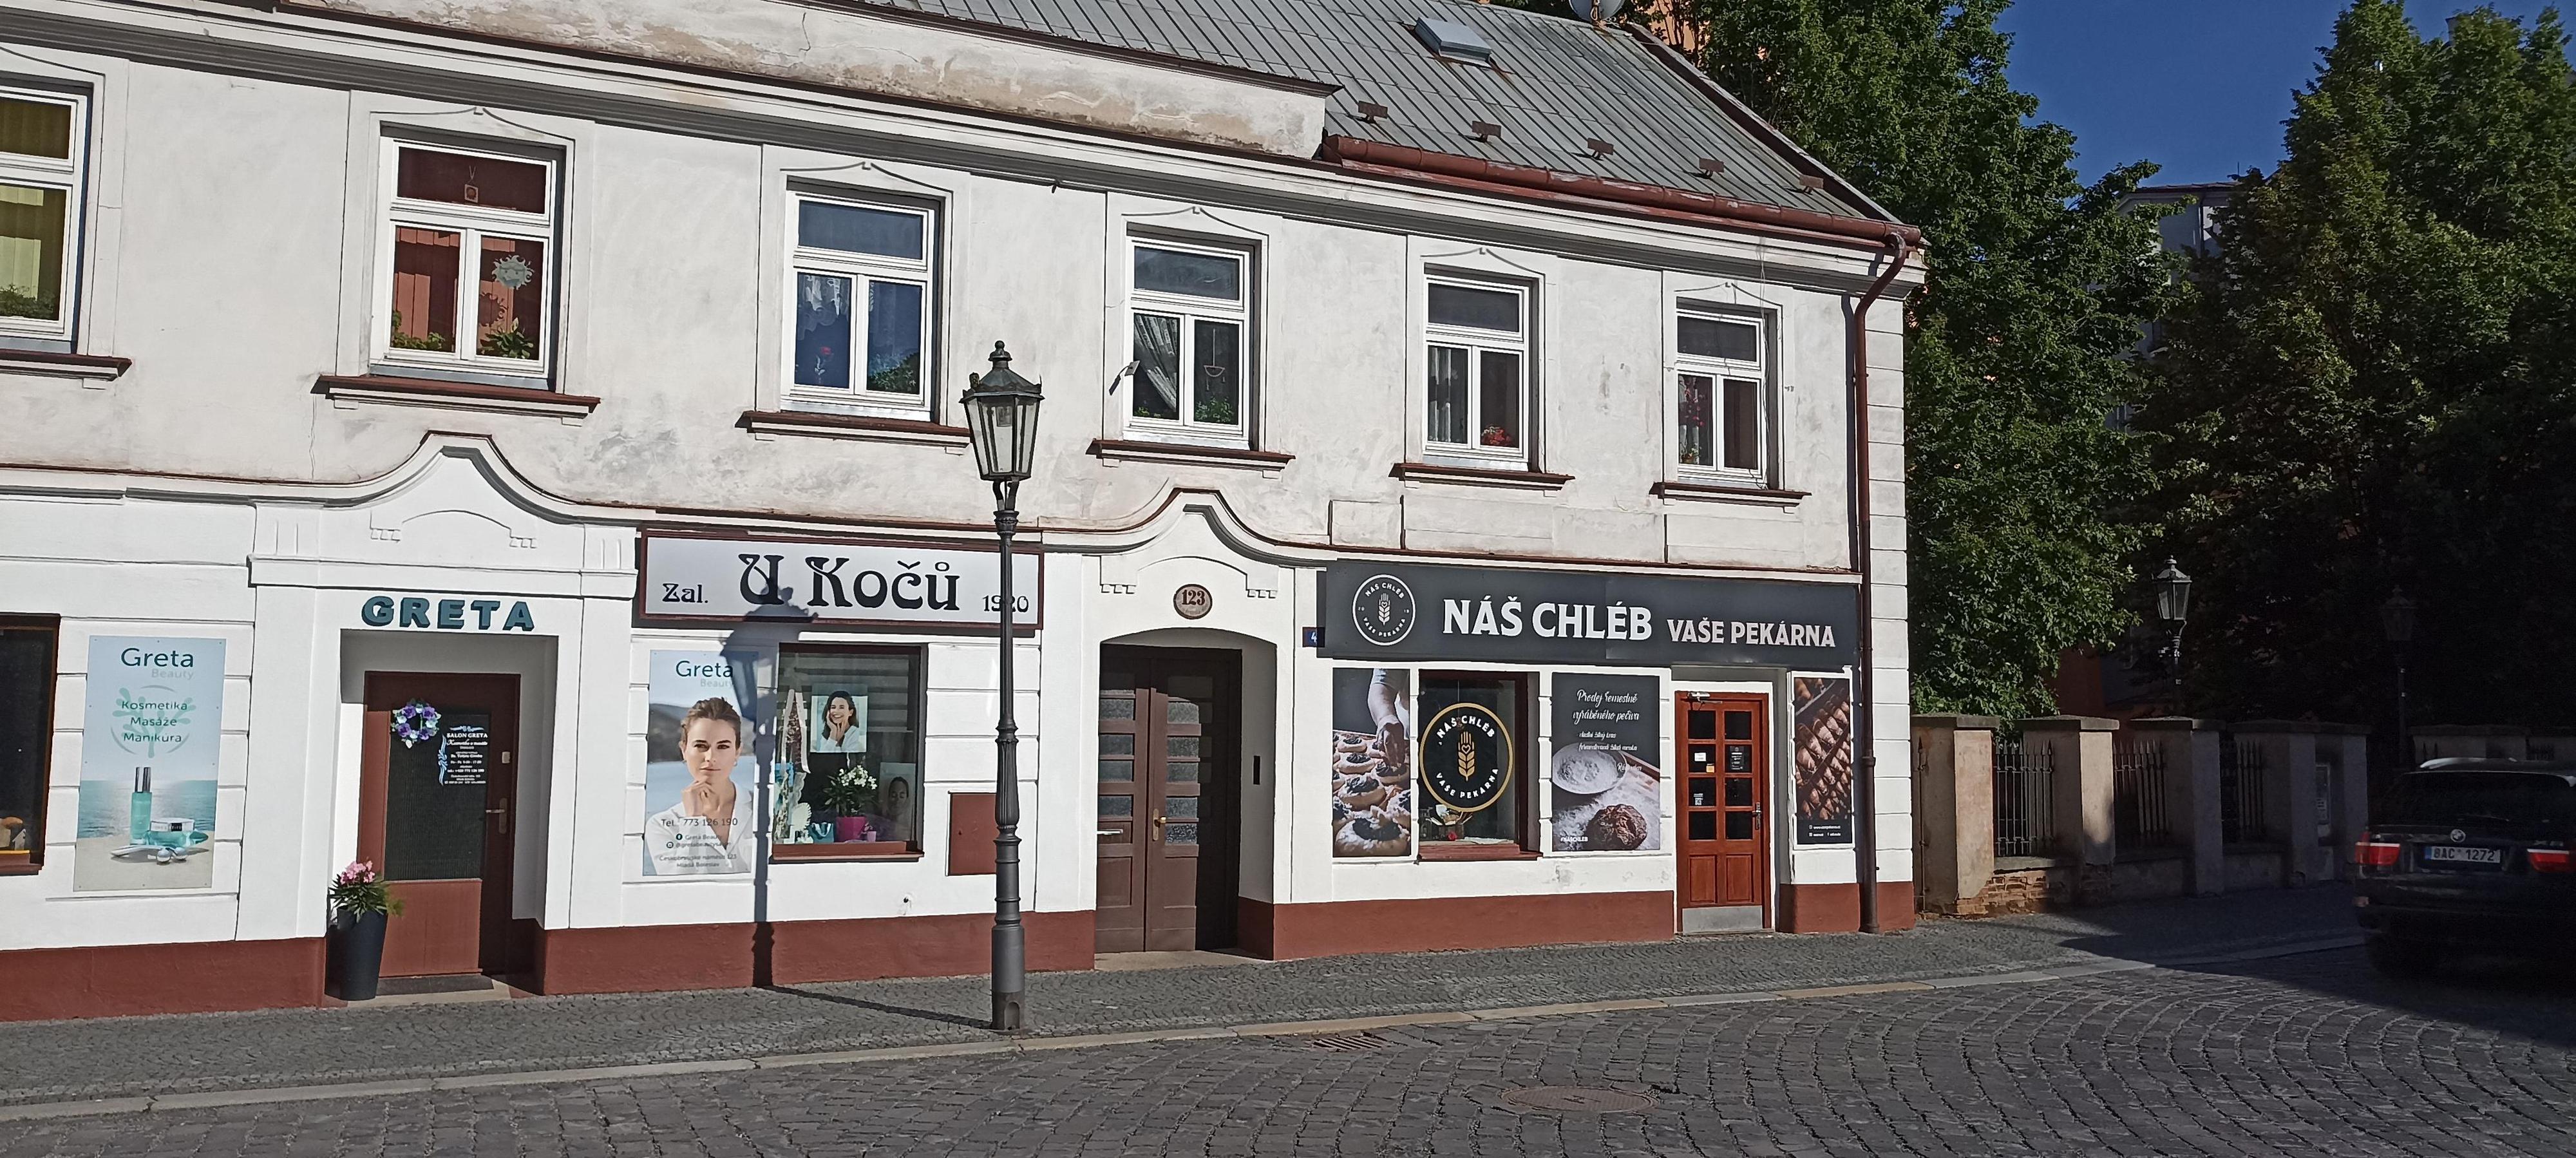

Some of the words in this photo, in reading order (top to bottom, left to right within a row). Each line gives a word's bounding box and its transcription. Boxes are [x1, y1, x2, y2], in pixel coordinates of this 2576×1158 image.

[662, 584, 708, 603] Zal.
[739, 553, 784, 605] U
[806, 556, 960, 610] Kočů
[983, 594, 1029, 612] 190
[1182, 589, 1206, 605] 123
[361, 595, 535, 632] GRETA
[1443, 595, 1522, 636] NÁŠ
[1532, 602, 1652, 641] CHLÉB
[1667, 618, 1725, 644] VAŠE
[1730, 620, 1835, 647] PEKÁRNA
[121, 647, 194, 667] Greta
[151, 669, 194, 680] Beauty
[676, 660, 734, 678] Greta
[701, 678, 734, 689] Beauty
[122, 701, 187, 710] Kosmetika
[131, 716, 177, 726] Masáže
[123, 732, 182, 742] Manikúra
[703, 818, 718, 826] 126
[722, 817, 738, 826] 190
[2467, 849, 2495, 861] 1272
